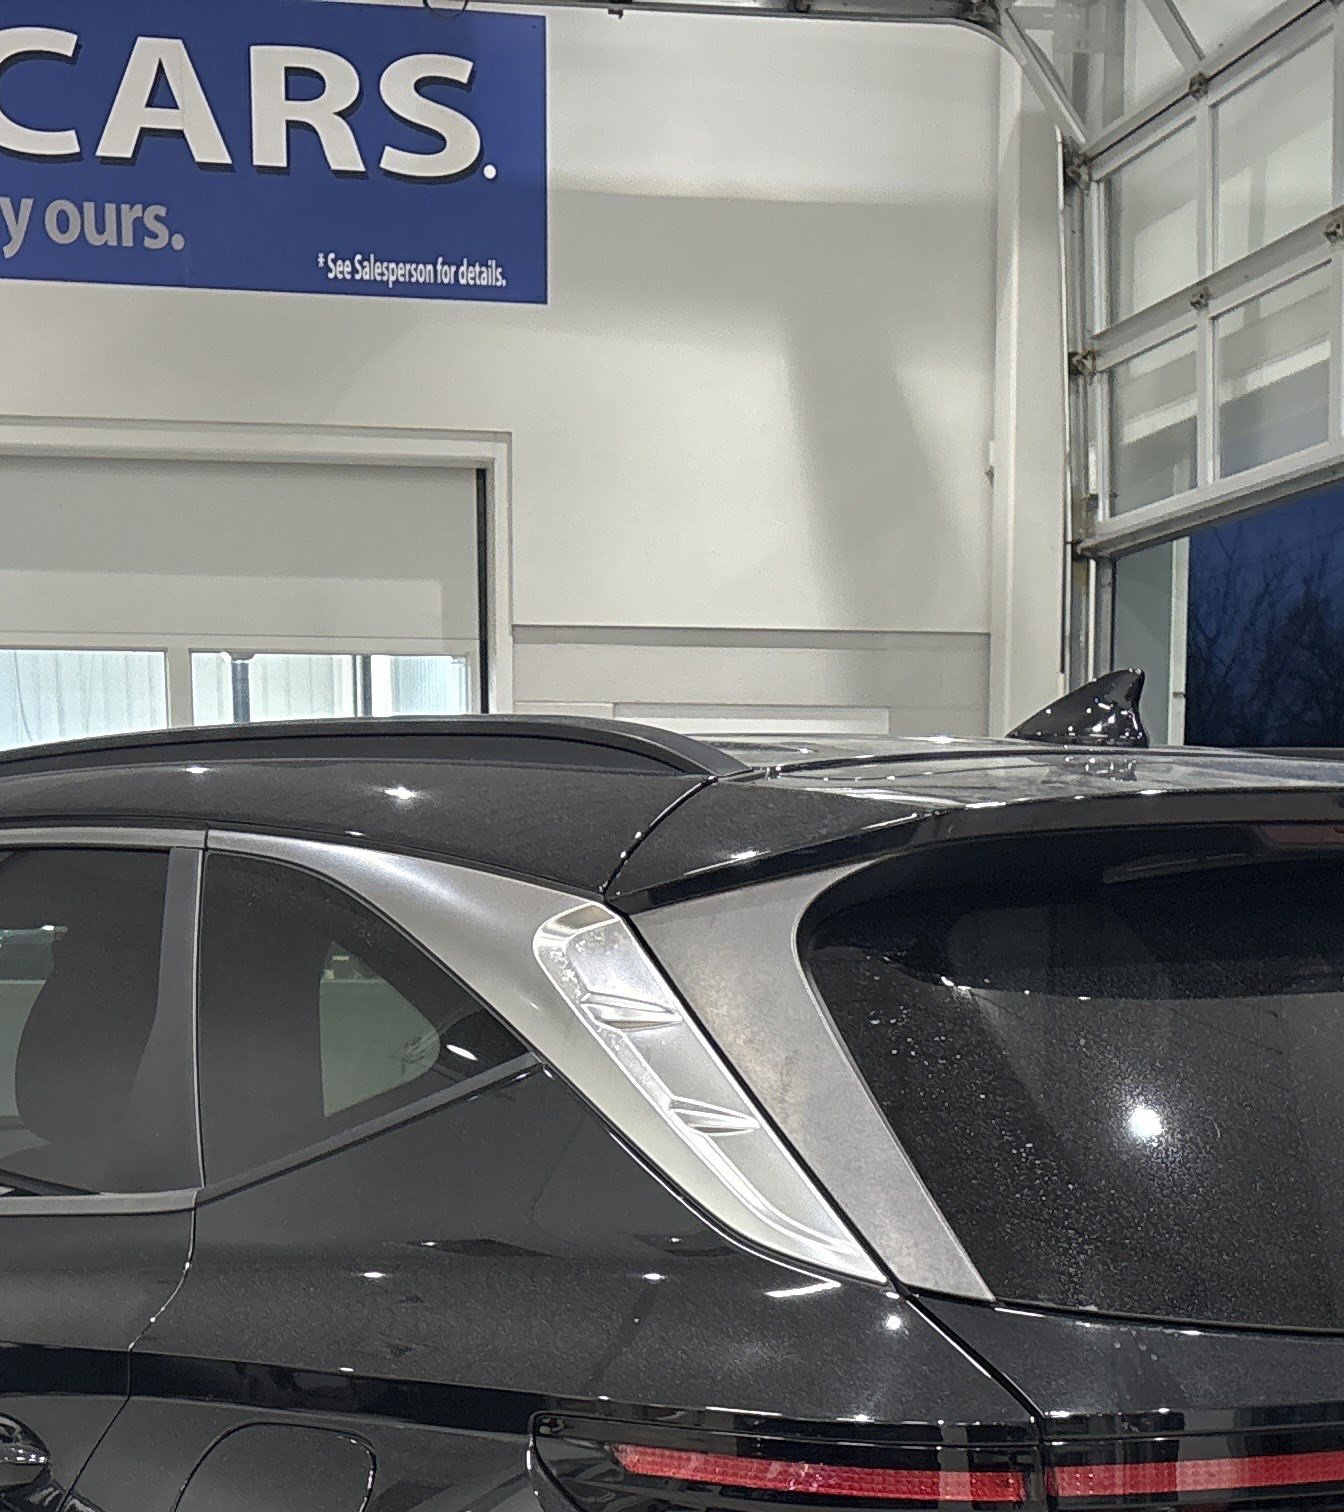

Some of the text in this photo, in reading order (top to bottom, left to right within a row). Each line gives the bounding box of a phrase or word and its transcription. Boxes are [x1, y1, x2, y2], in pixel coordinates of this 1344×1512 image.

[44, 198, 186, 251] ours.
[353, 253, 435, 289] Salesperson
[436, 256, 457, 285] for
